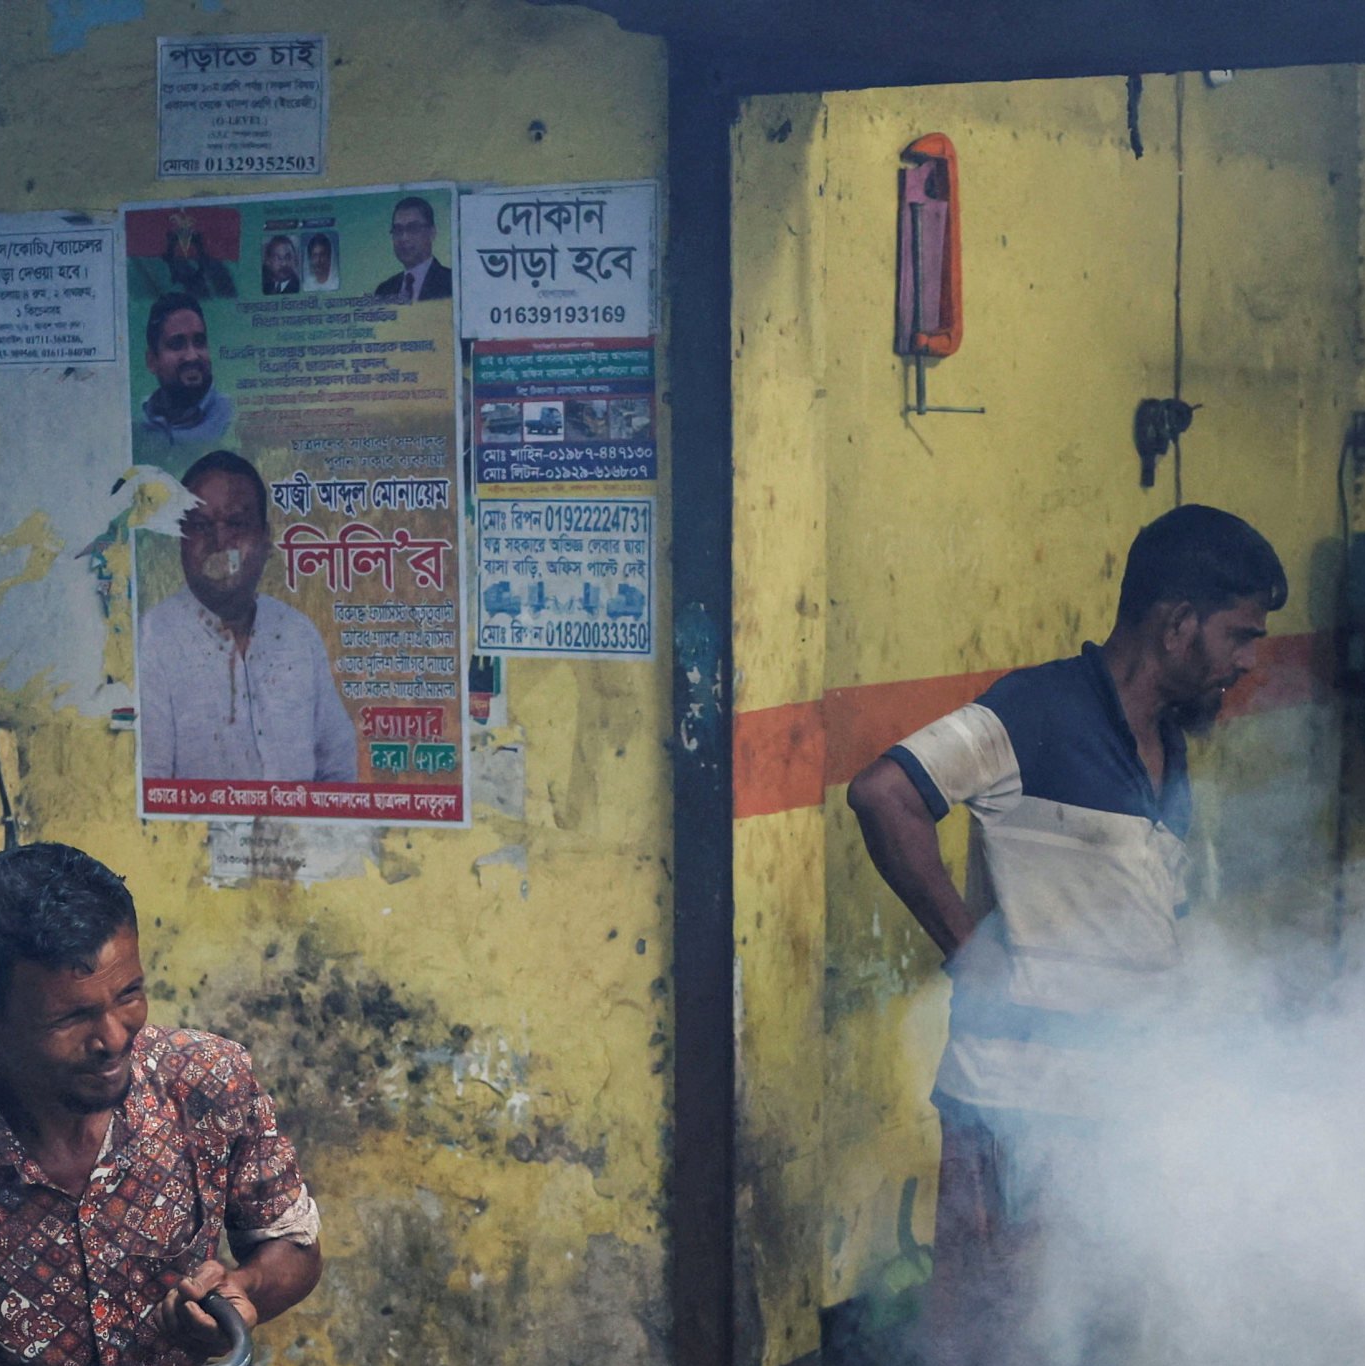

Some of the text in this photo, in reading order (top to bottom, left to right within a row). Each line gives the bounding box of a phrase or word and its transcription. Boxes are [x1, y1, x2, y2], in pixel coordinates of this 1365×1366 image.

[170, 39, 316, 72] পড়াতে চাই
[204, 156, 316, 172] 01329352503
[497, 197, 608, 236] দোকান
[476, 243, 638, 288] ভাড়া হবে
[490, 305, 626, 324] 01639193169
[482, 448, 506, 463] মোঃ
[483, 467, 507, 481] মোঃ
[373, 476, 450, 509] মোনায়েম
[482, 502, 648, 533] মোঃ রিপন 01922224731
[504, 537, 546, 553] সহকারে
[549, 533, 584, 553] অভিজ্ঞ
[588, 538, 620, 554] লেবার
[483, 559, 509, 575] বাসা
[546, 555, 583, 576] অফিস
[587, 558, 618, 576] পাল্টে
[623, 558, 647, 580] দেই
[482, 624, 507, 643] মোঃ
[546, 620, 647, 649] 01820033350
[190, 789, 206, 804] ৯০
[210, 789, 226, 805] এর
